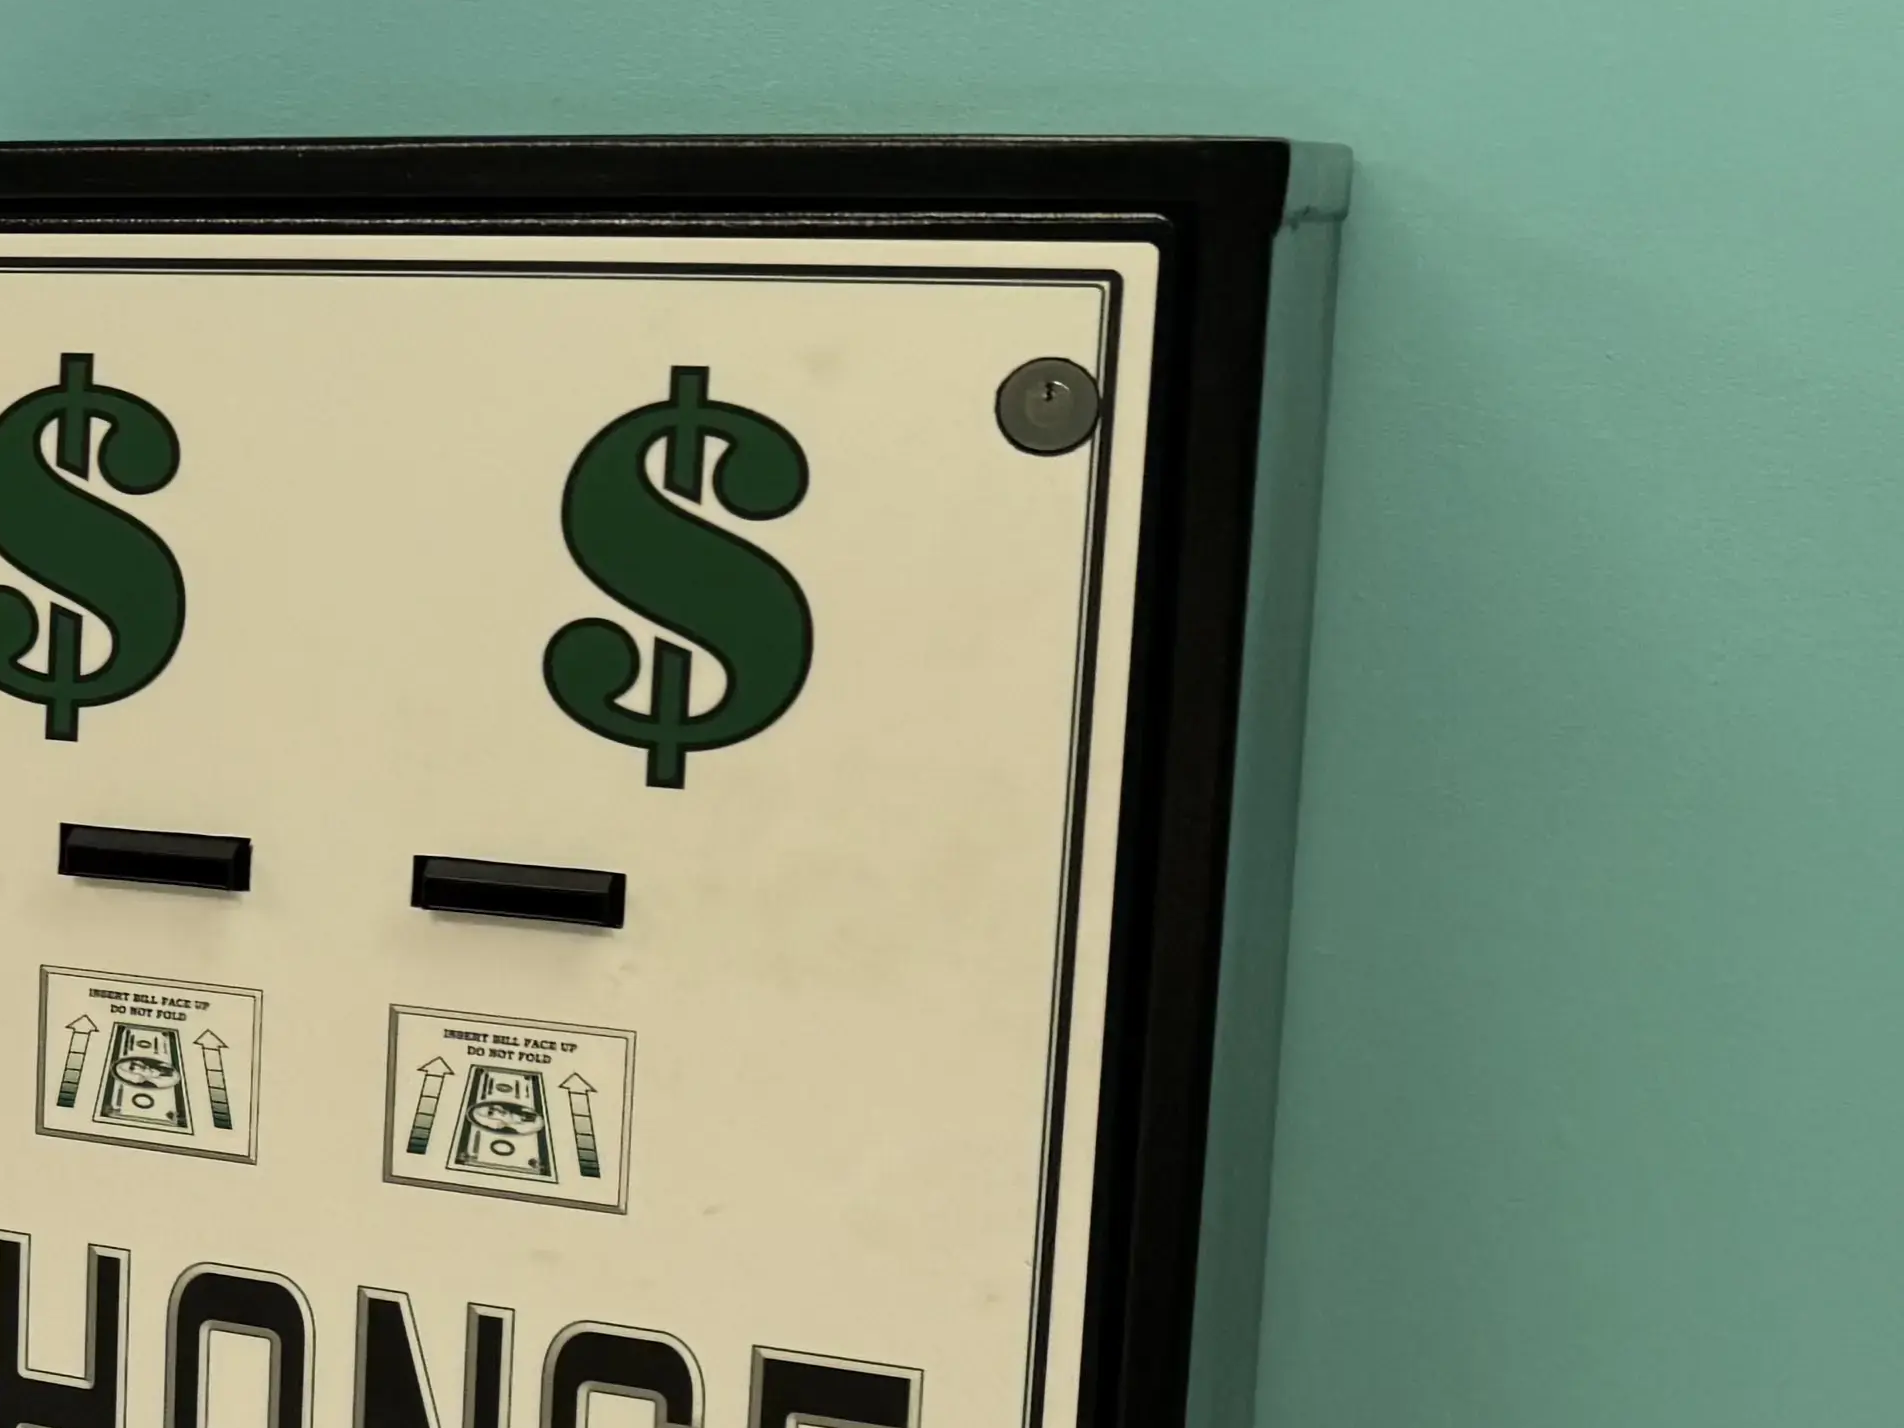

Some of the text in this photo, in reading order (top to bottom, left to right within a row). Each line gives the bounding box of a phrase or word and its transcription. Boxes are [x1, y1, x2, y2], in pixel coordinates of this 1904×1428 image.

[88, 987, 211, 1011] INSERT BILL FACE UP
[110, 1003, 188, 1022] DO NOT FOLD
[443, 1028, 579, 1053] INSERT BILL FACE UP
[467, 1045, 553, 1064] DO NOT FOLD
